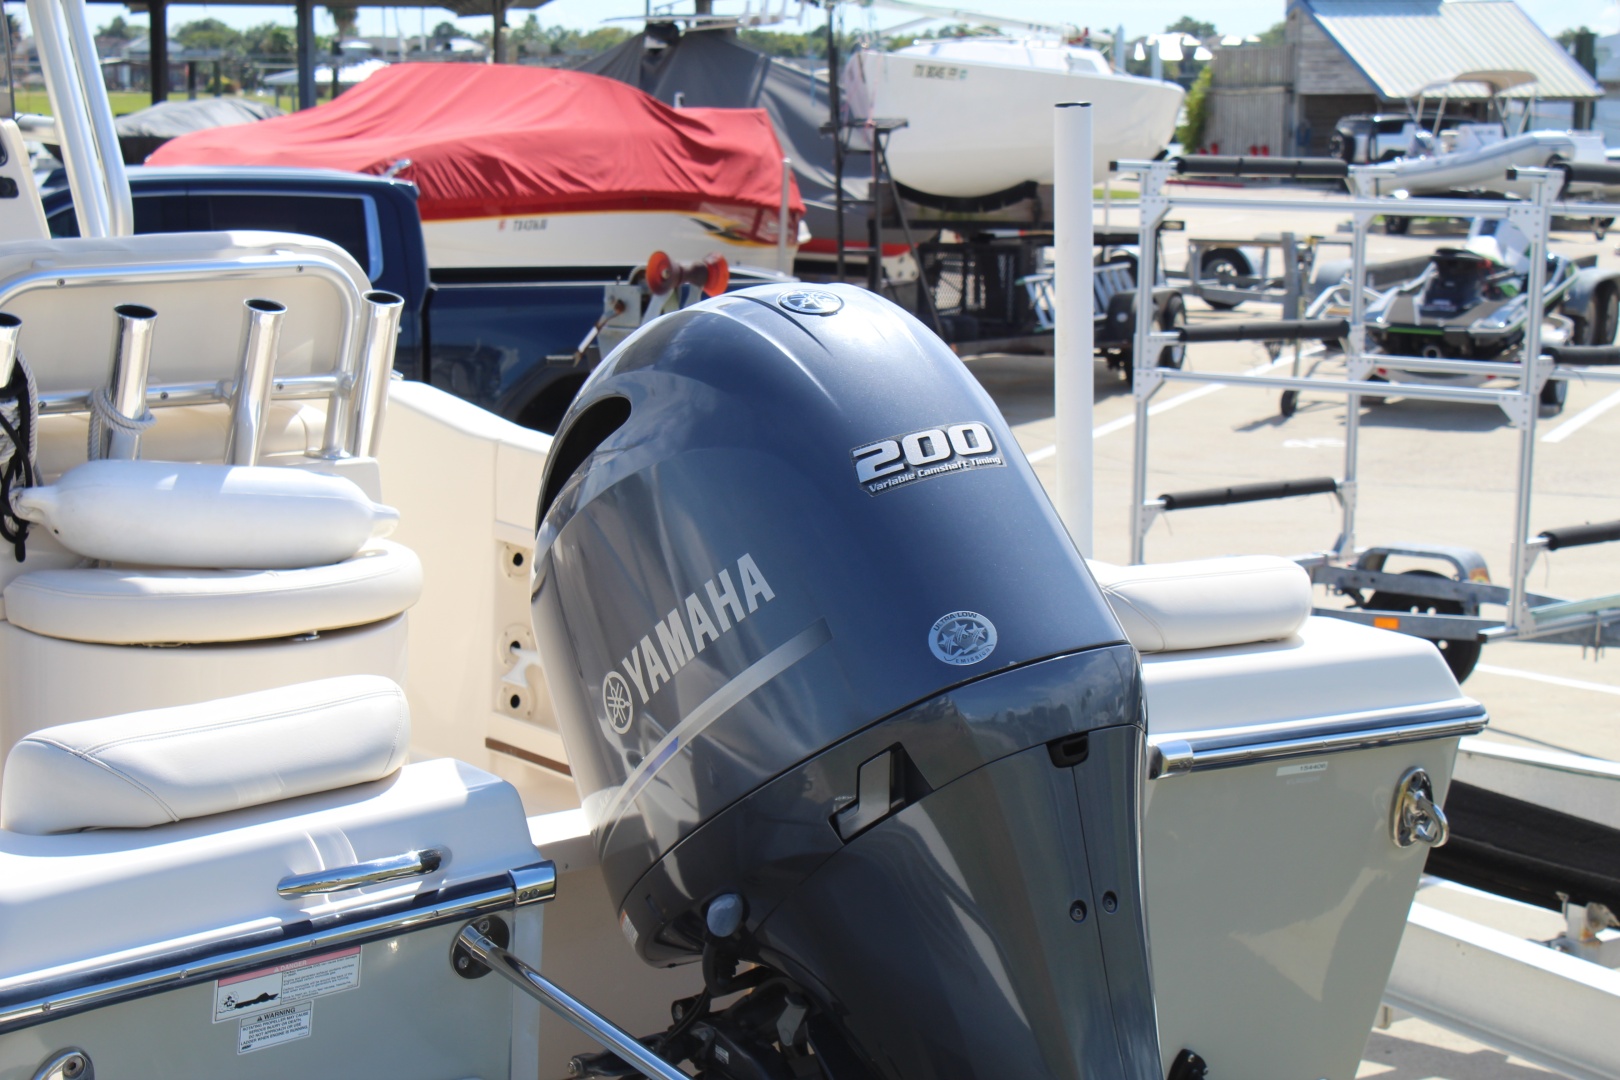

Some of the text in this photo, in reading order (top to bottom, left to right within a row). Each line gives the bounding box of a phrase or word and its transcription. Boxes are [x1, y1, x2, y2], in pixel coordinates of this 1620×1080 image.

[853, 424, 994, 484] 200
[868, 456, 1002, 493] Variable Camshaft Timing
[622, 552, 776, 704] YAMAHA
[933, 614, 956, 631] ULTRA
[280, 960, 307, 971] DANGER
[263, 1018, 285, 1026] PROPELLER
[264, 1008, 296, 1020] WARNING
